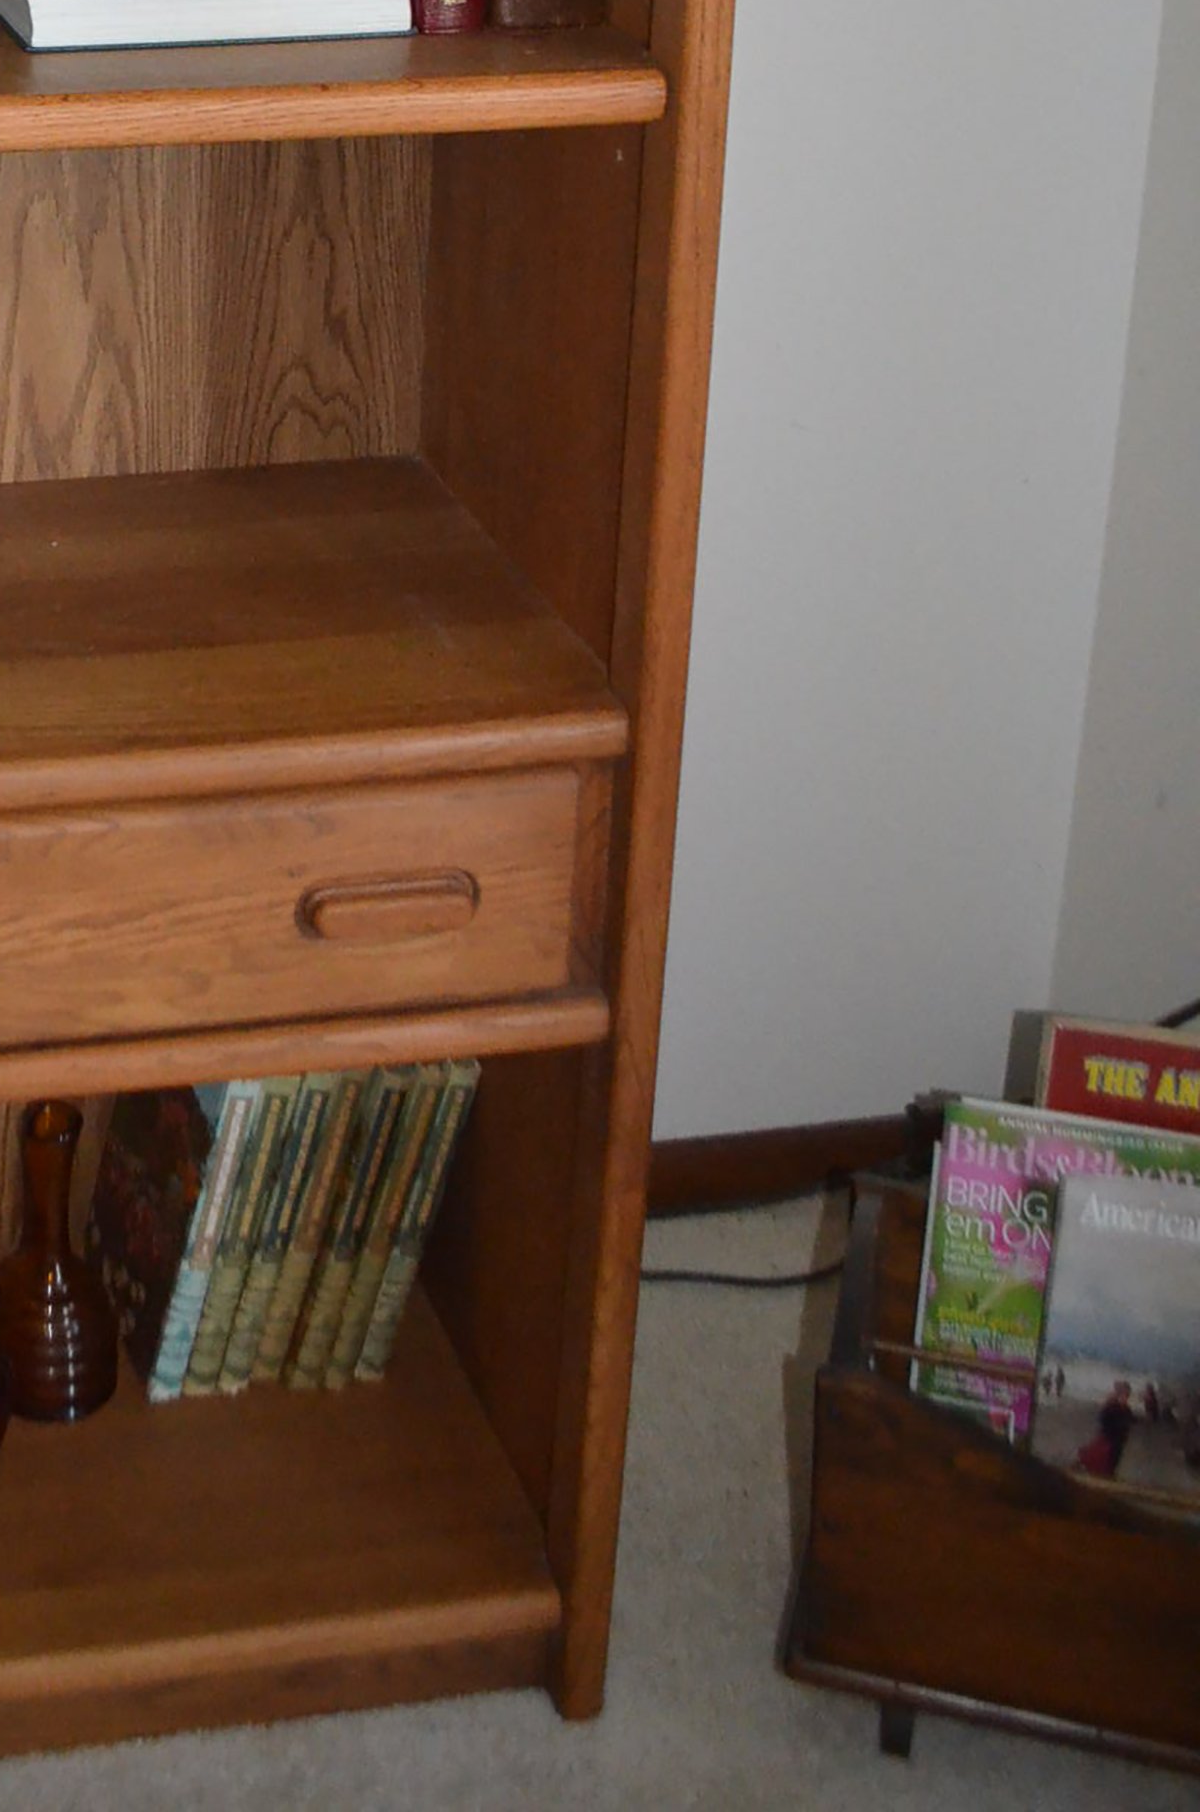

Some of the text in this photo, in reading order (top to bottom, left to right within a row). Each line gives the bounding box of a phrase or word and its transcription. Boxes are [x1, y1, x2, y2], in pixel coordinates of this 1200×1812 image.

[1084, 1055, 1150, 1100] THE
[942, 1121, 1050, 1180] Birds
[947, 1174, 1048, 1224] BRING
